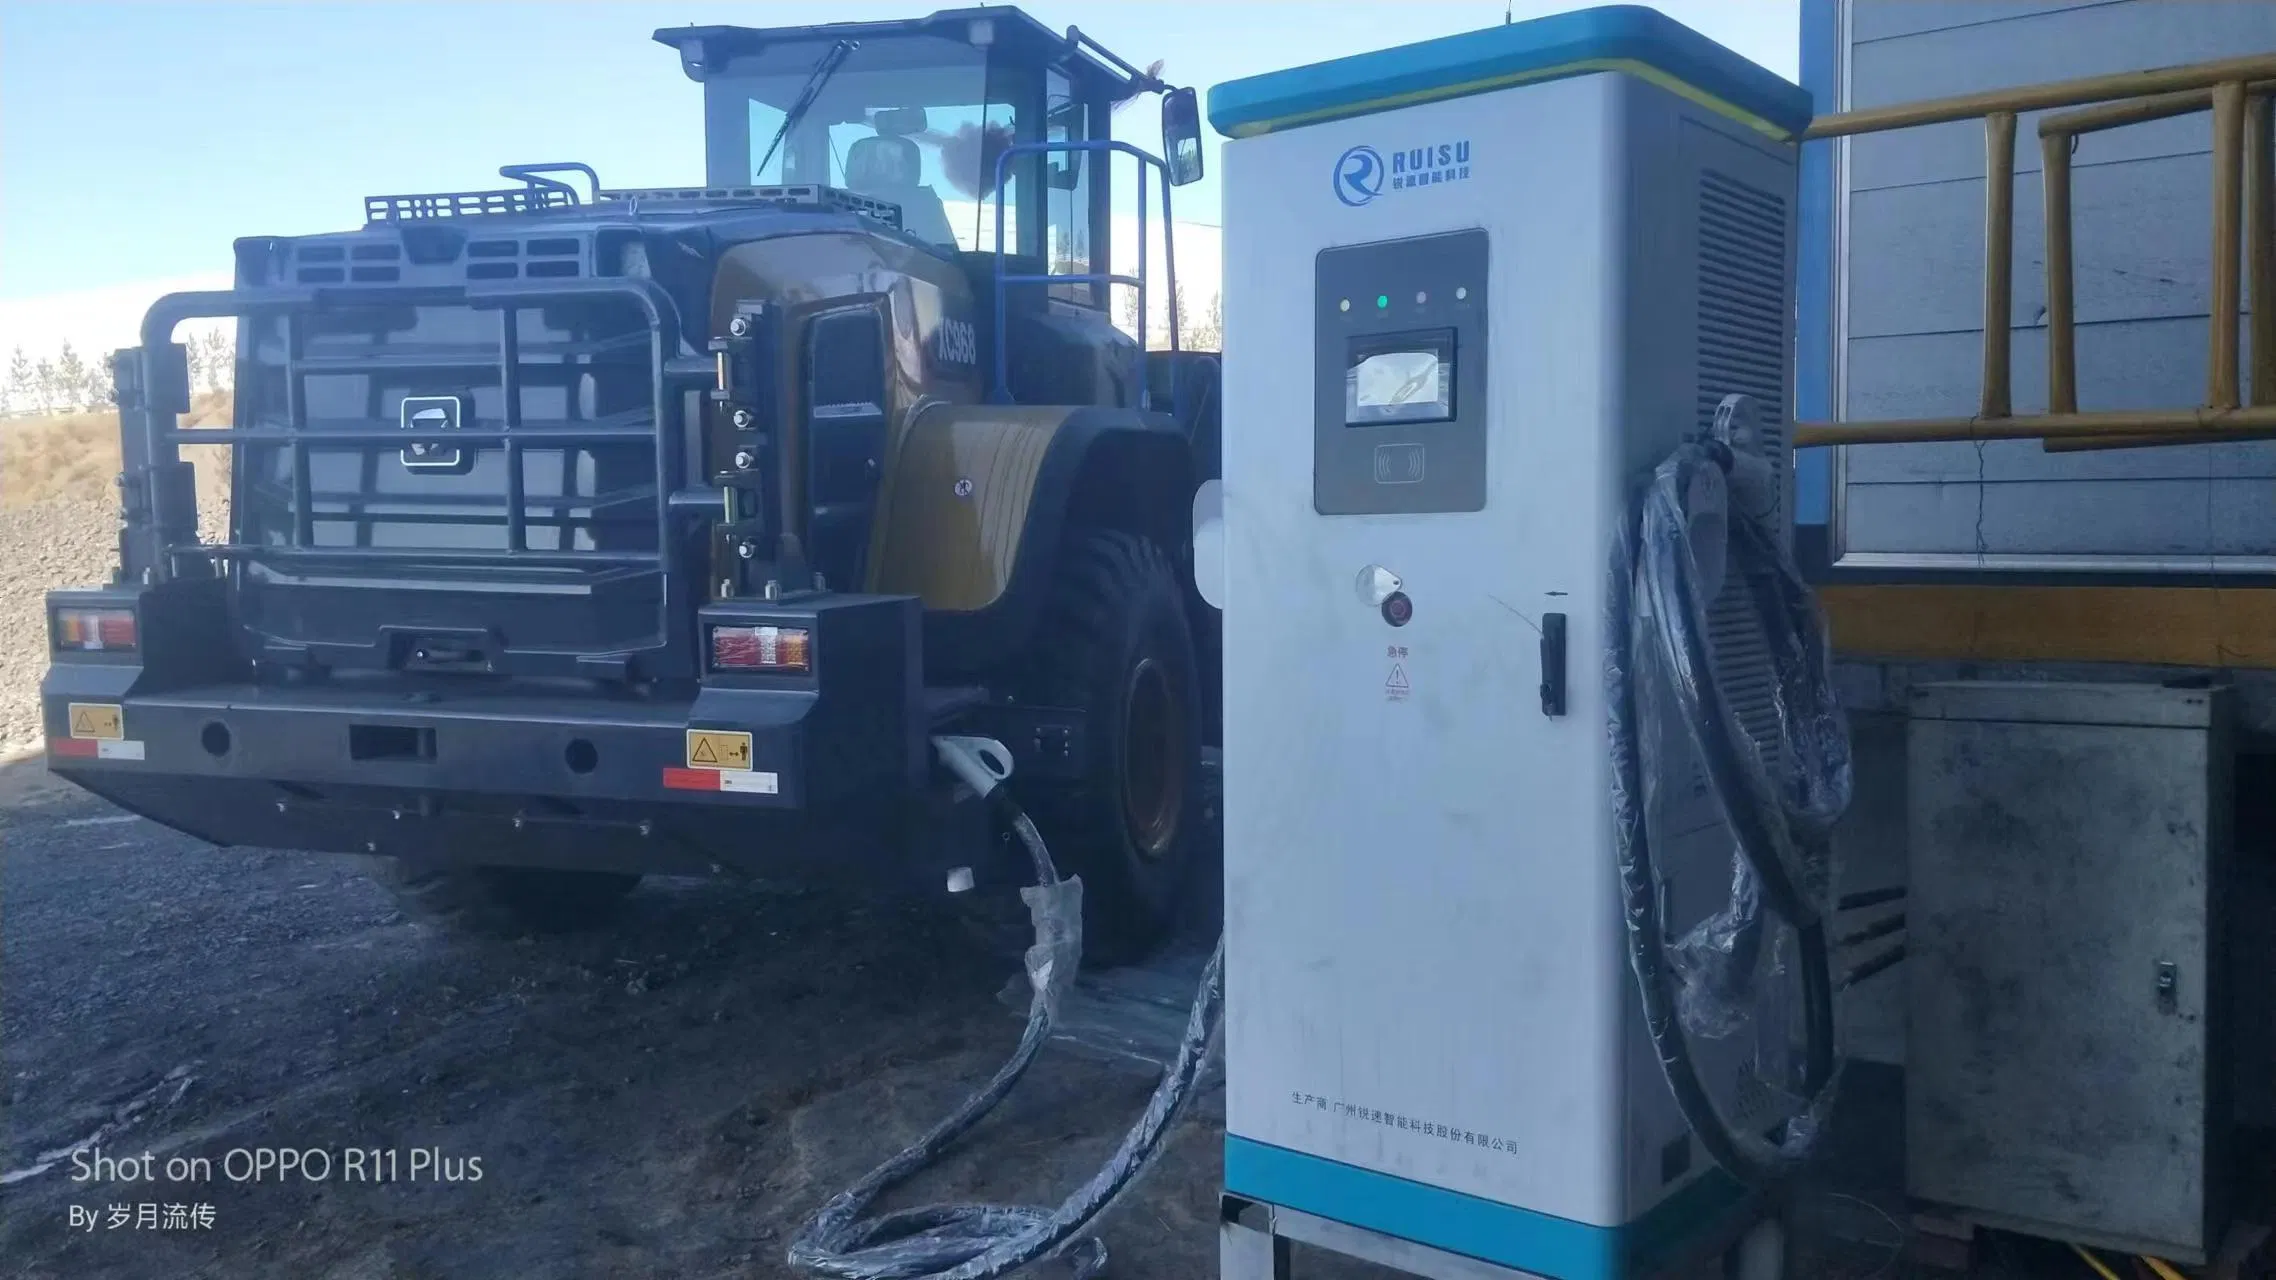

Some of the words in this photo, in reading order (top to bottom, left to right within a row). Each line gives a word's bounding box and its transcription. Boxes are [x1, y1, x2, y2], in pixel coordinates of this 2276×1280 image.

[1393, 141, 1470, 174] RUISU
[1292, 1091, 1327, 1110] 生产商
[1333, 1102, 1518, 1154] 广州锐速智能科技股份有限公司
